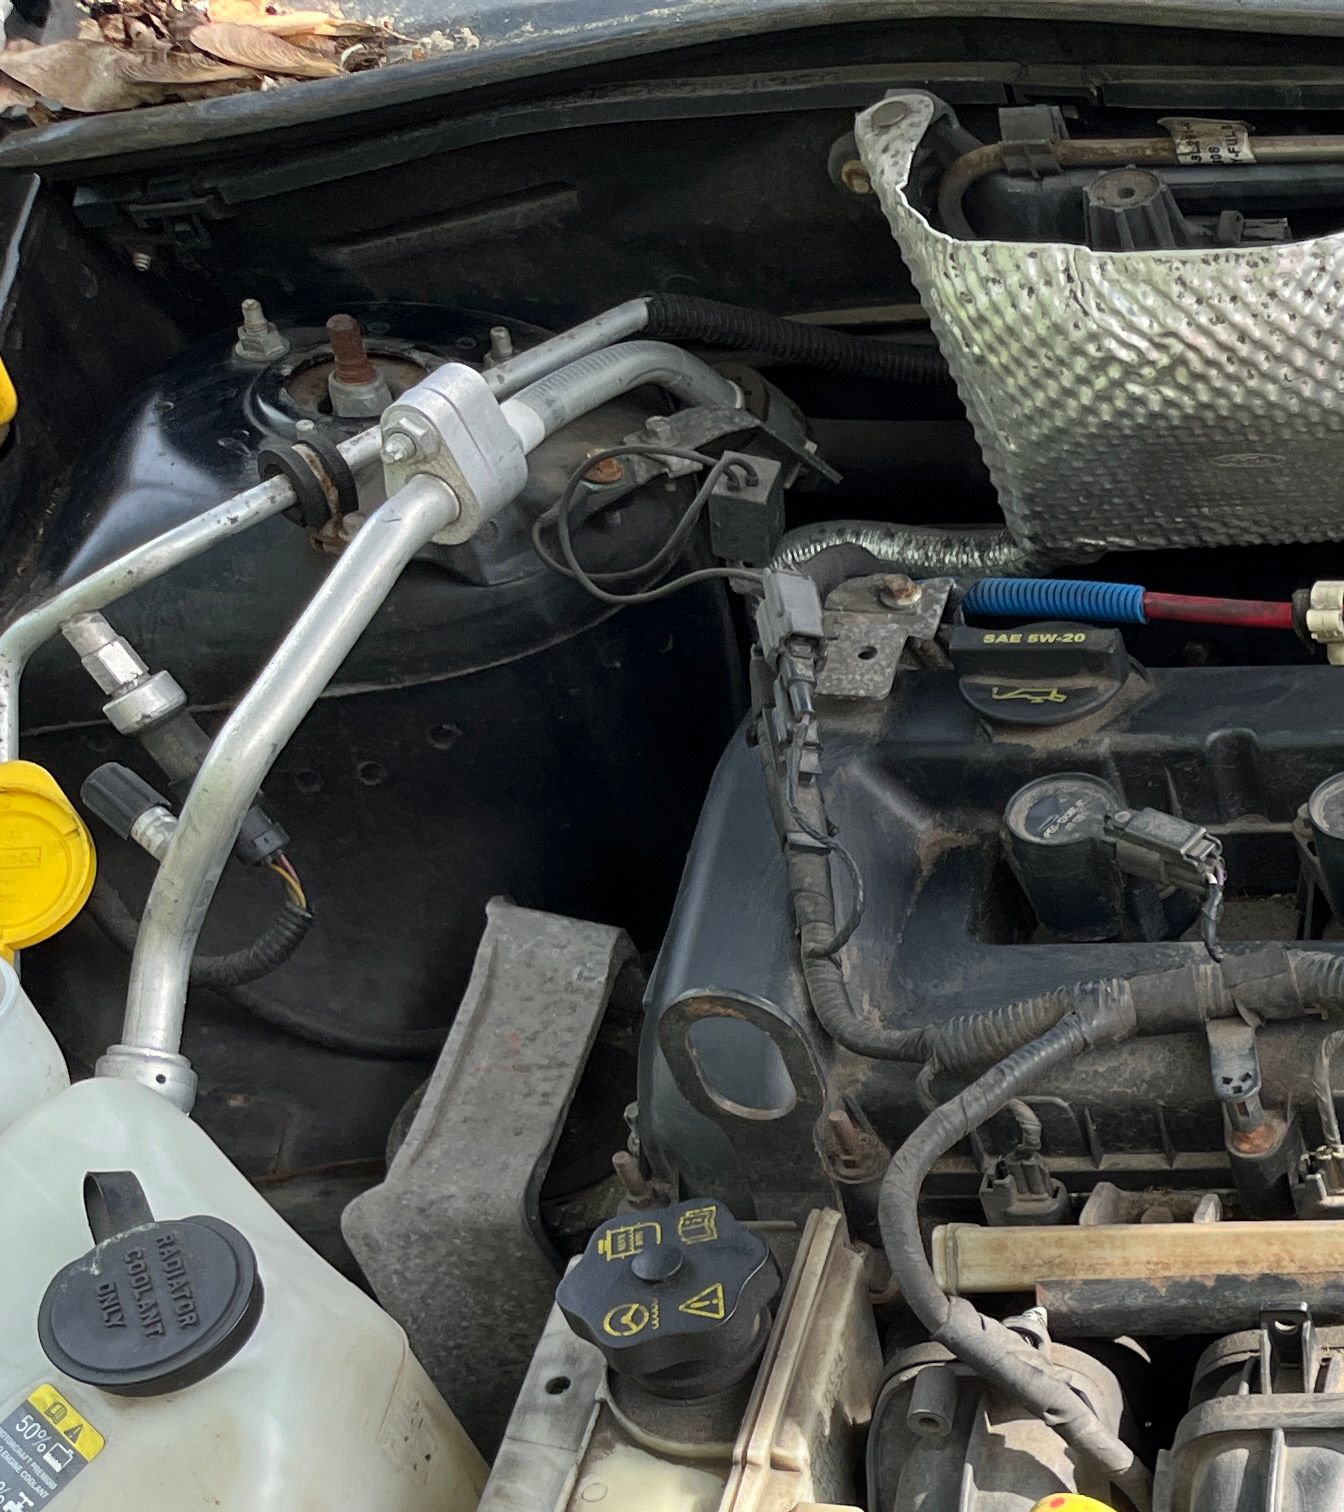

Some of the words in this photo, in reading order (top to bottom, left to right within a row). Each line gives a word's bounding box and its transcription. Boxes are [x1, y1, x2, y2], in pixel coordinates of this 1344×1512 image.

[983, 633, 1023, 644] SAE
[1027, 632, 1086, 644] 5W-20
[124, 1249, 166, 1339] COOLANT
[156, 1232, 201, 1331] RADIATOR
[97, 1280, 127, 1330] ONLY
[15, 1414, 53, 1453] 50%
[20, 1469, 50, 1499] COOLANT
[30, 1460, 58, 1491] PREMIUM
